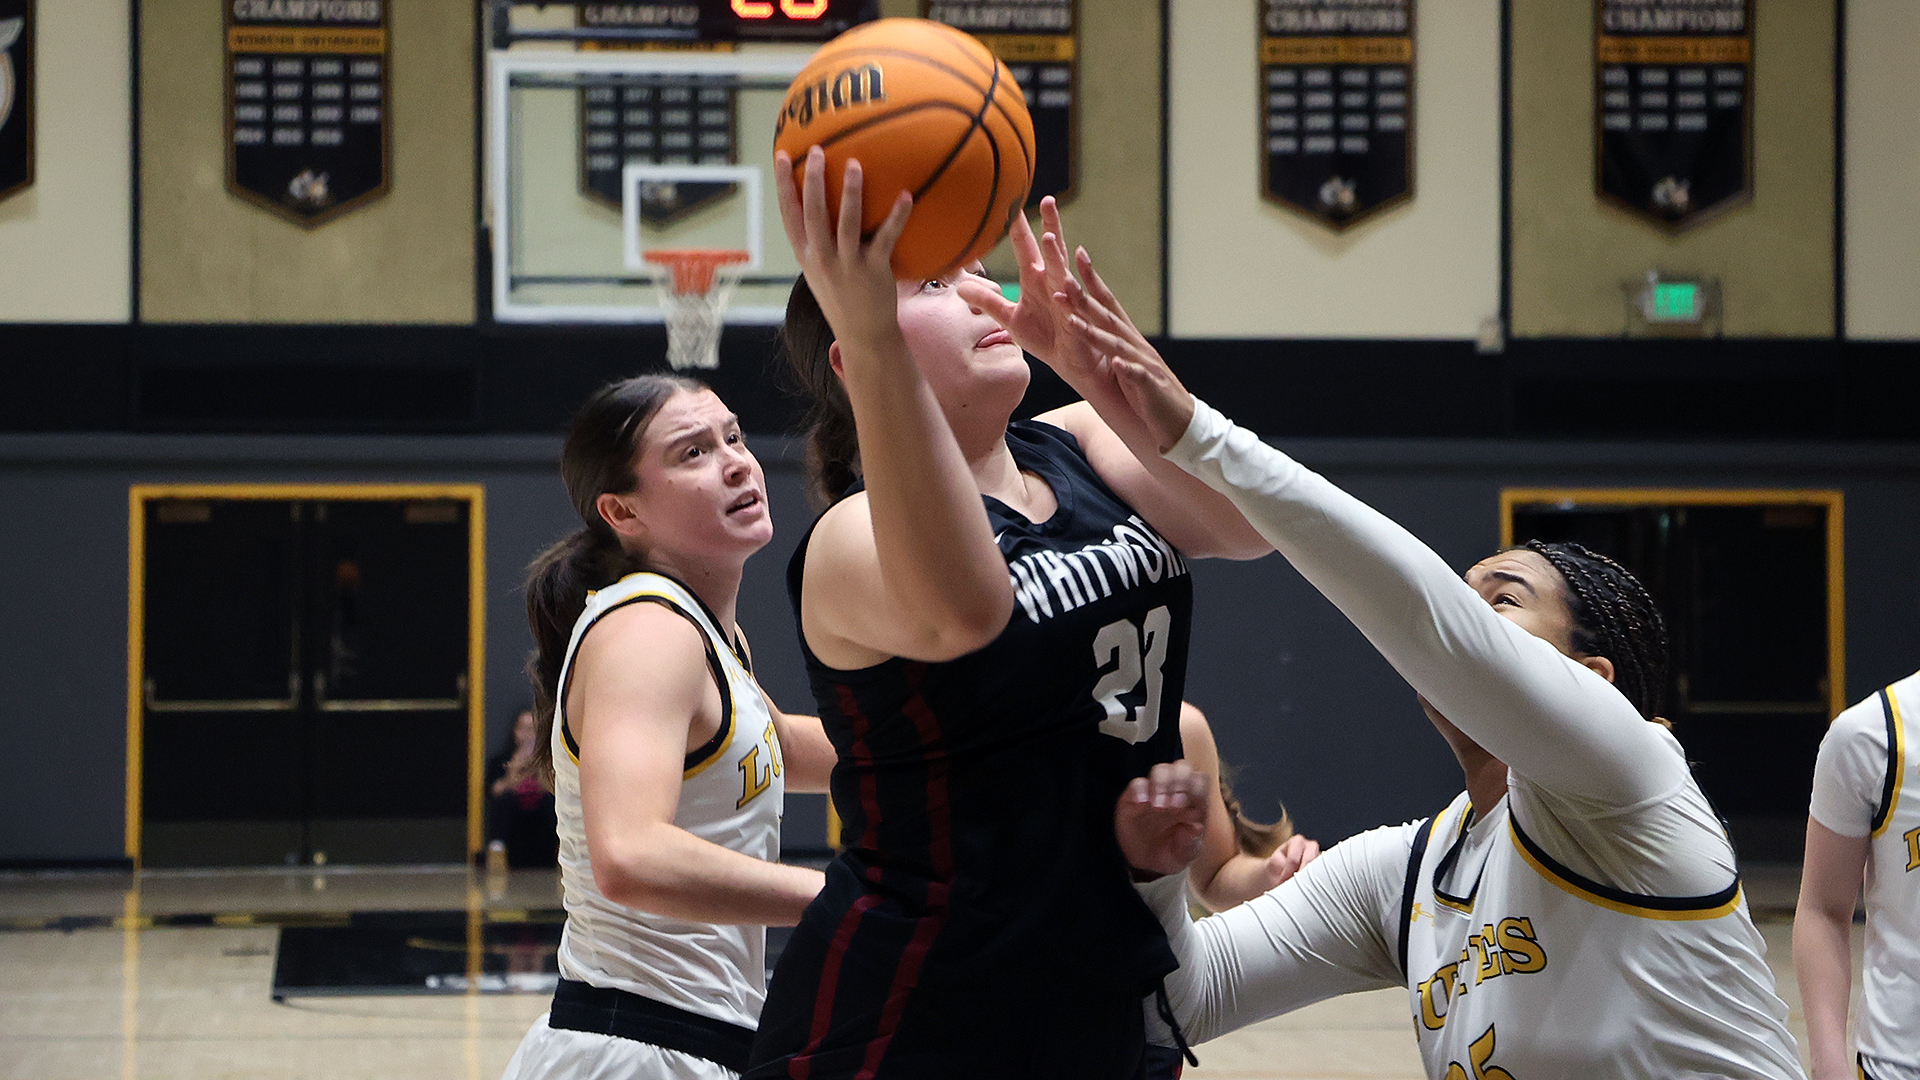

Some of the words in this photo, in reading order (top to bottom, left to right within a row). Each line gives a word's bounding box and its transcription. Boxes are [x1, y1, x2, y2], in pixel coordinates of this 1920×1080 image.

[233, 0, 380, 20] CHAMPIONS
[585, 5, 699, 24] CHAMPIO
[1265, 9, 1407, 32] CHAMPIONS
[1092, 605, 1171, 745] 23
